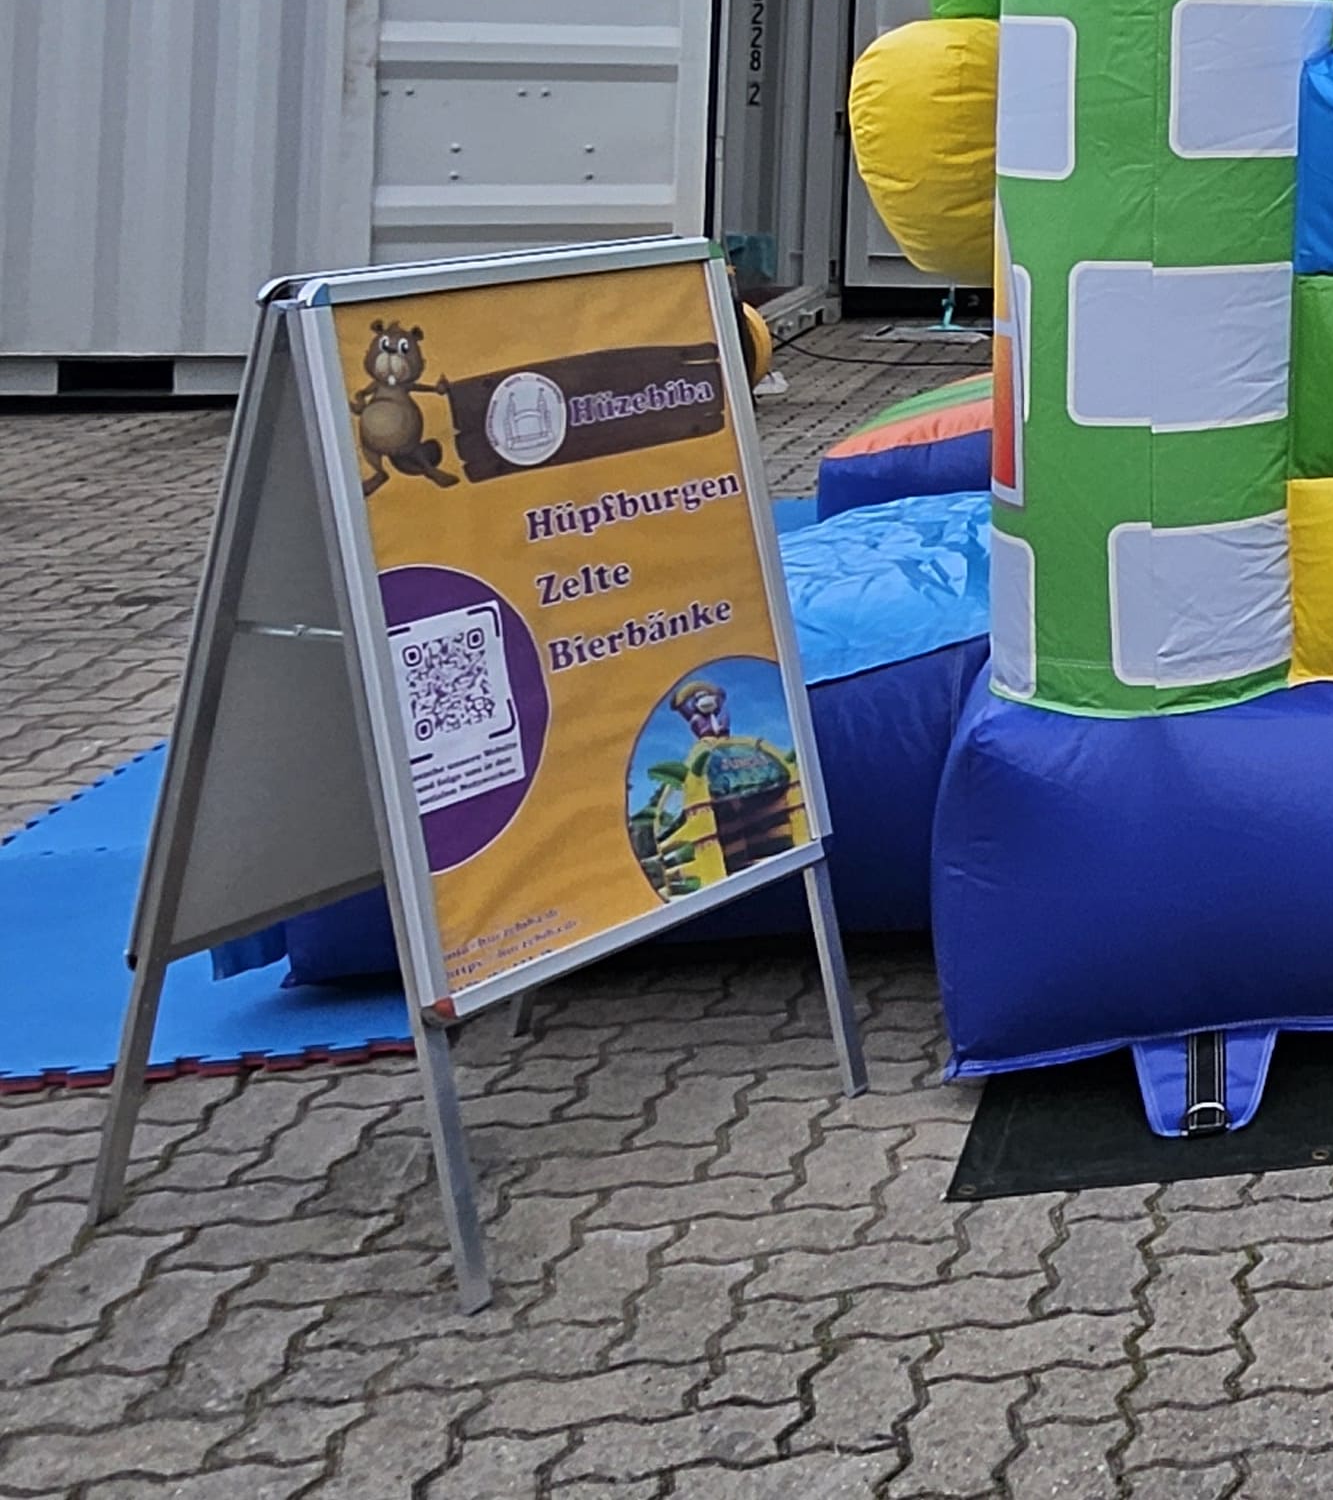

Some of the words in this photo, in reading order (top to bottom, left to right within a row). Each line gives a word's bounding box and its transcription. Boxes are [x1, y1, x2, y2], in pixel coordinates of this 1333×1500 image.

[748, 83, 760, 106] 2
[569, 379, 714, 426] Hüzebiba
[525, 473, 741, 542] Hüpfburgen
[535, 563, 631, 607] Zelte
[547, 600, 732, 673] Bierbänke
